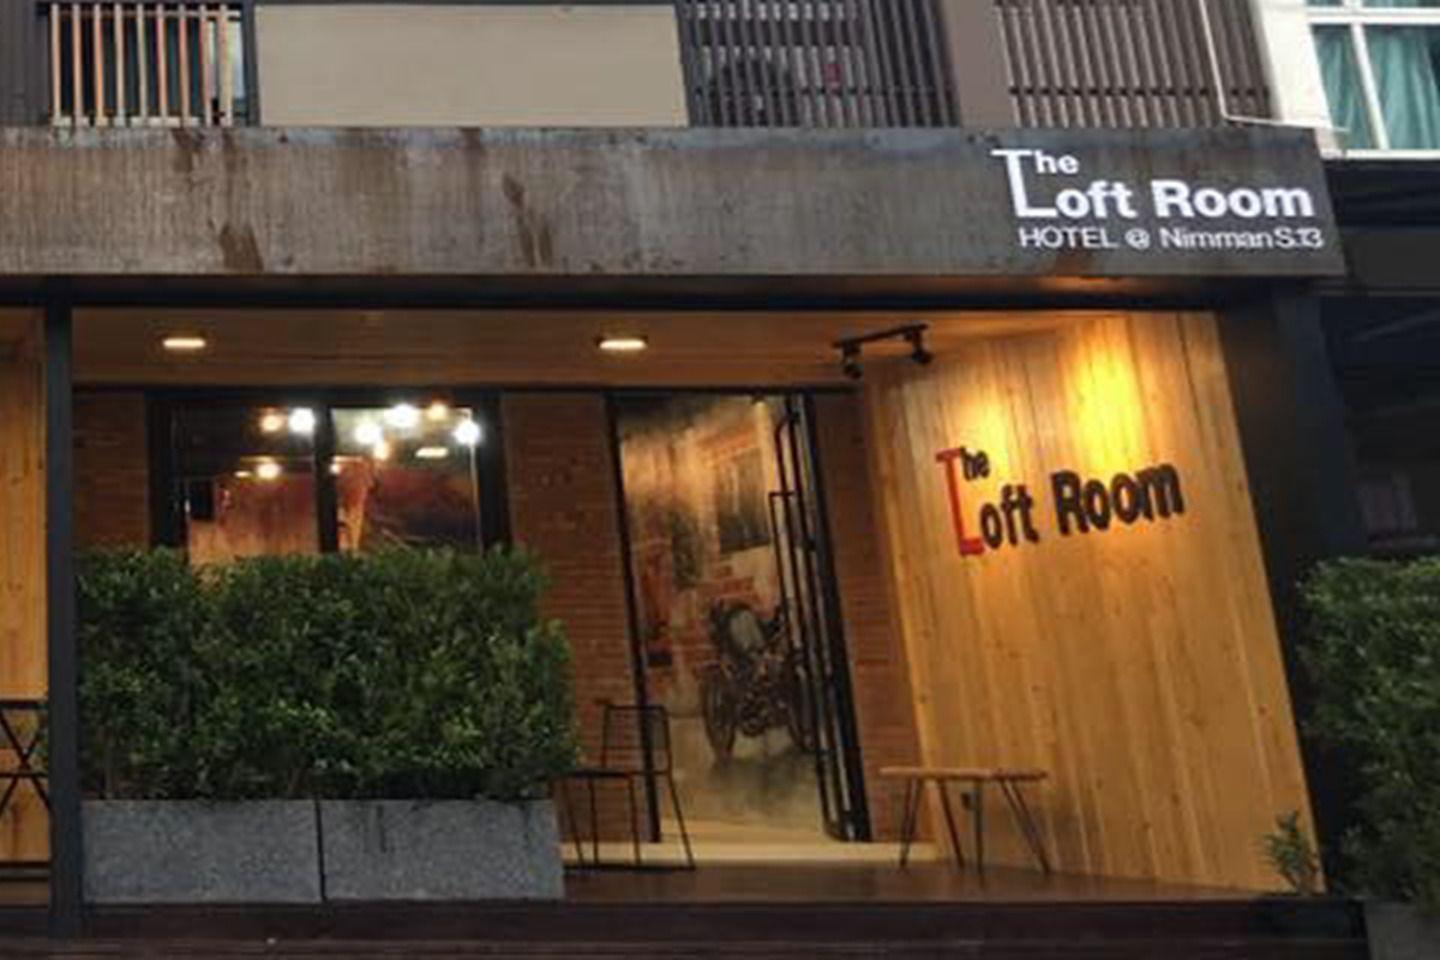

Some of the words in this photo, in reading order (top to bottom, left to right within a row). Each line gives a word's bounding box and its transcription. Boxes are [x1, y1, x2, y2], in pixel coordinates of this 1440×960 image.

[1010, 162, 1137, 218] Loft
[1151, 179, 1314, 217] Room
[1018, 227, 1117, 248] HOTEL
[1125, 228, 1150, 249] @
[1051, 463, 1185, 536] Room
